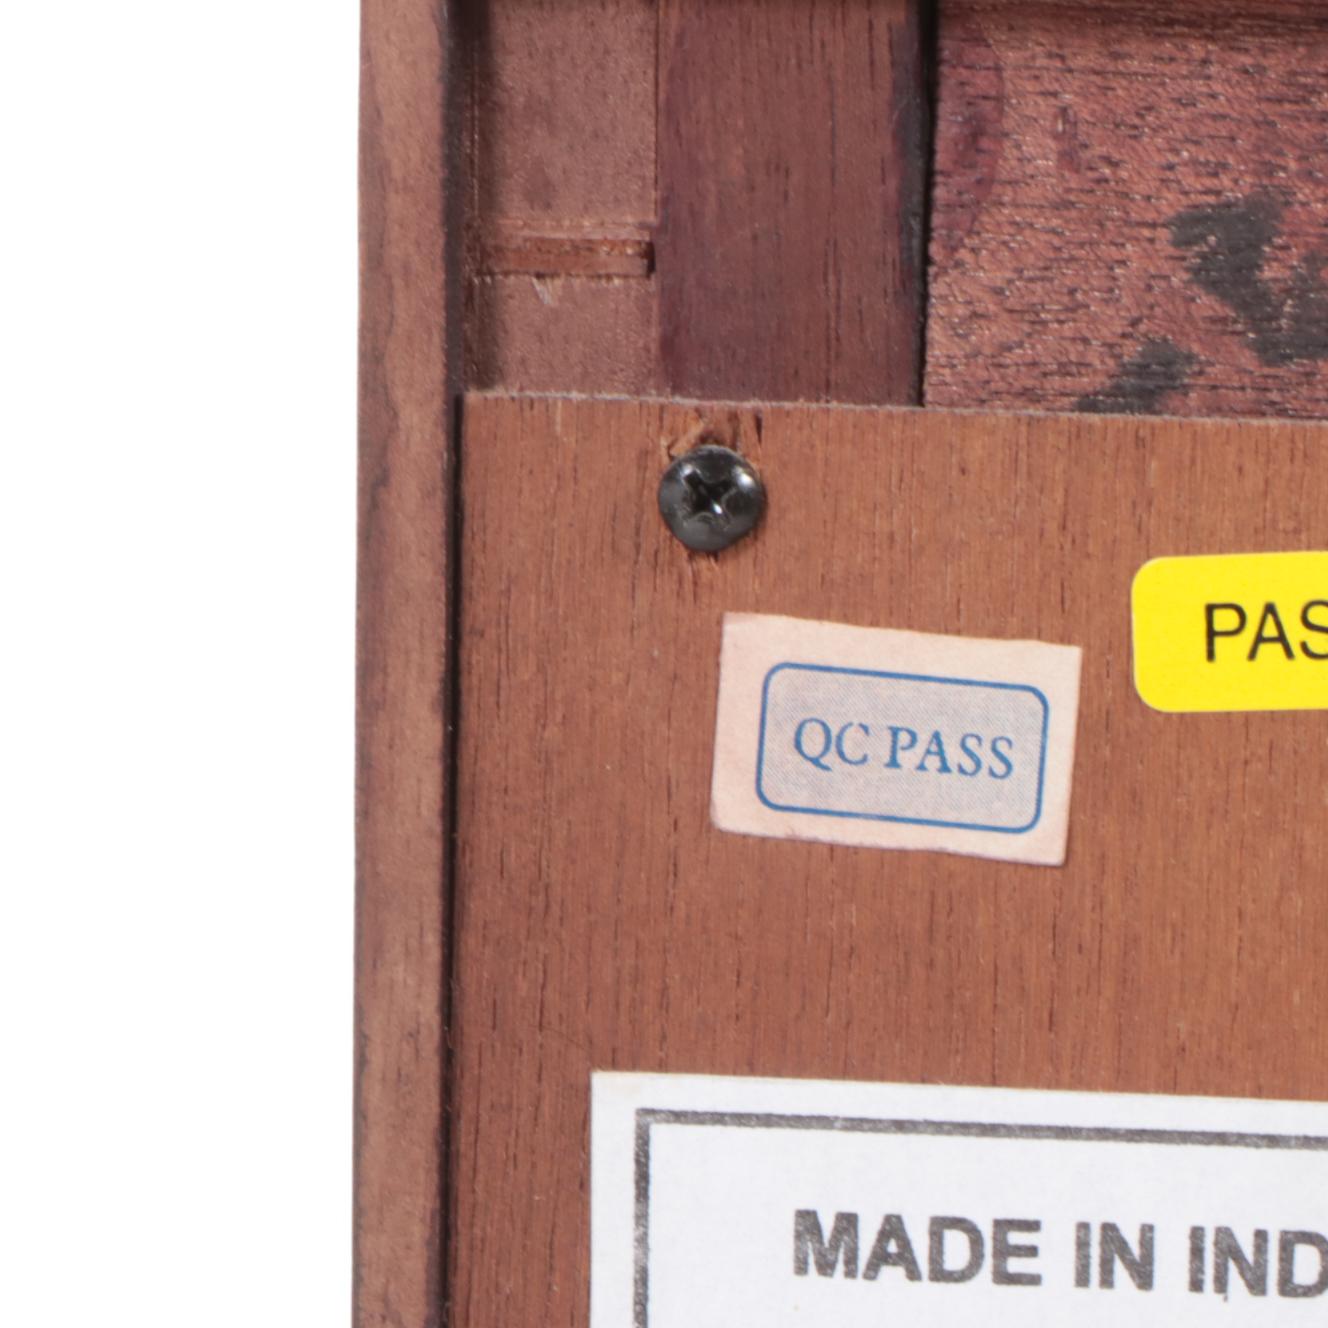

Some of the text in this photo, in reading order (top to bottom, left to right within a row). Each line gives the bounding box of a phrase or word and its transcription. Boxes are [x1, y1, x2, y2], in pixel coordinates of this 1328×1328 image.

[793, 718, 1015, 780] QC PASS
[795, 1209, 1042, 1286] MADE
[1075, 1222, 1155, 1291] IN
